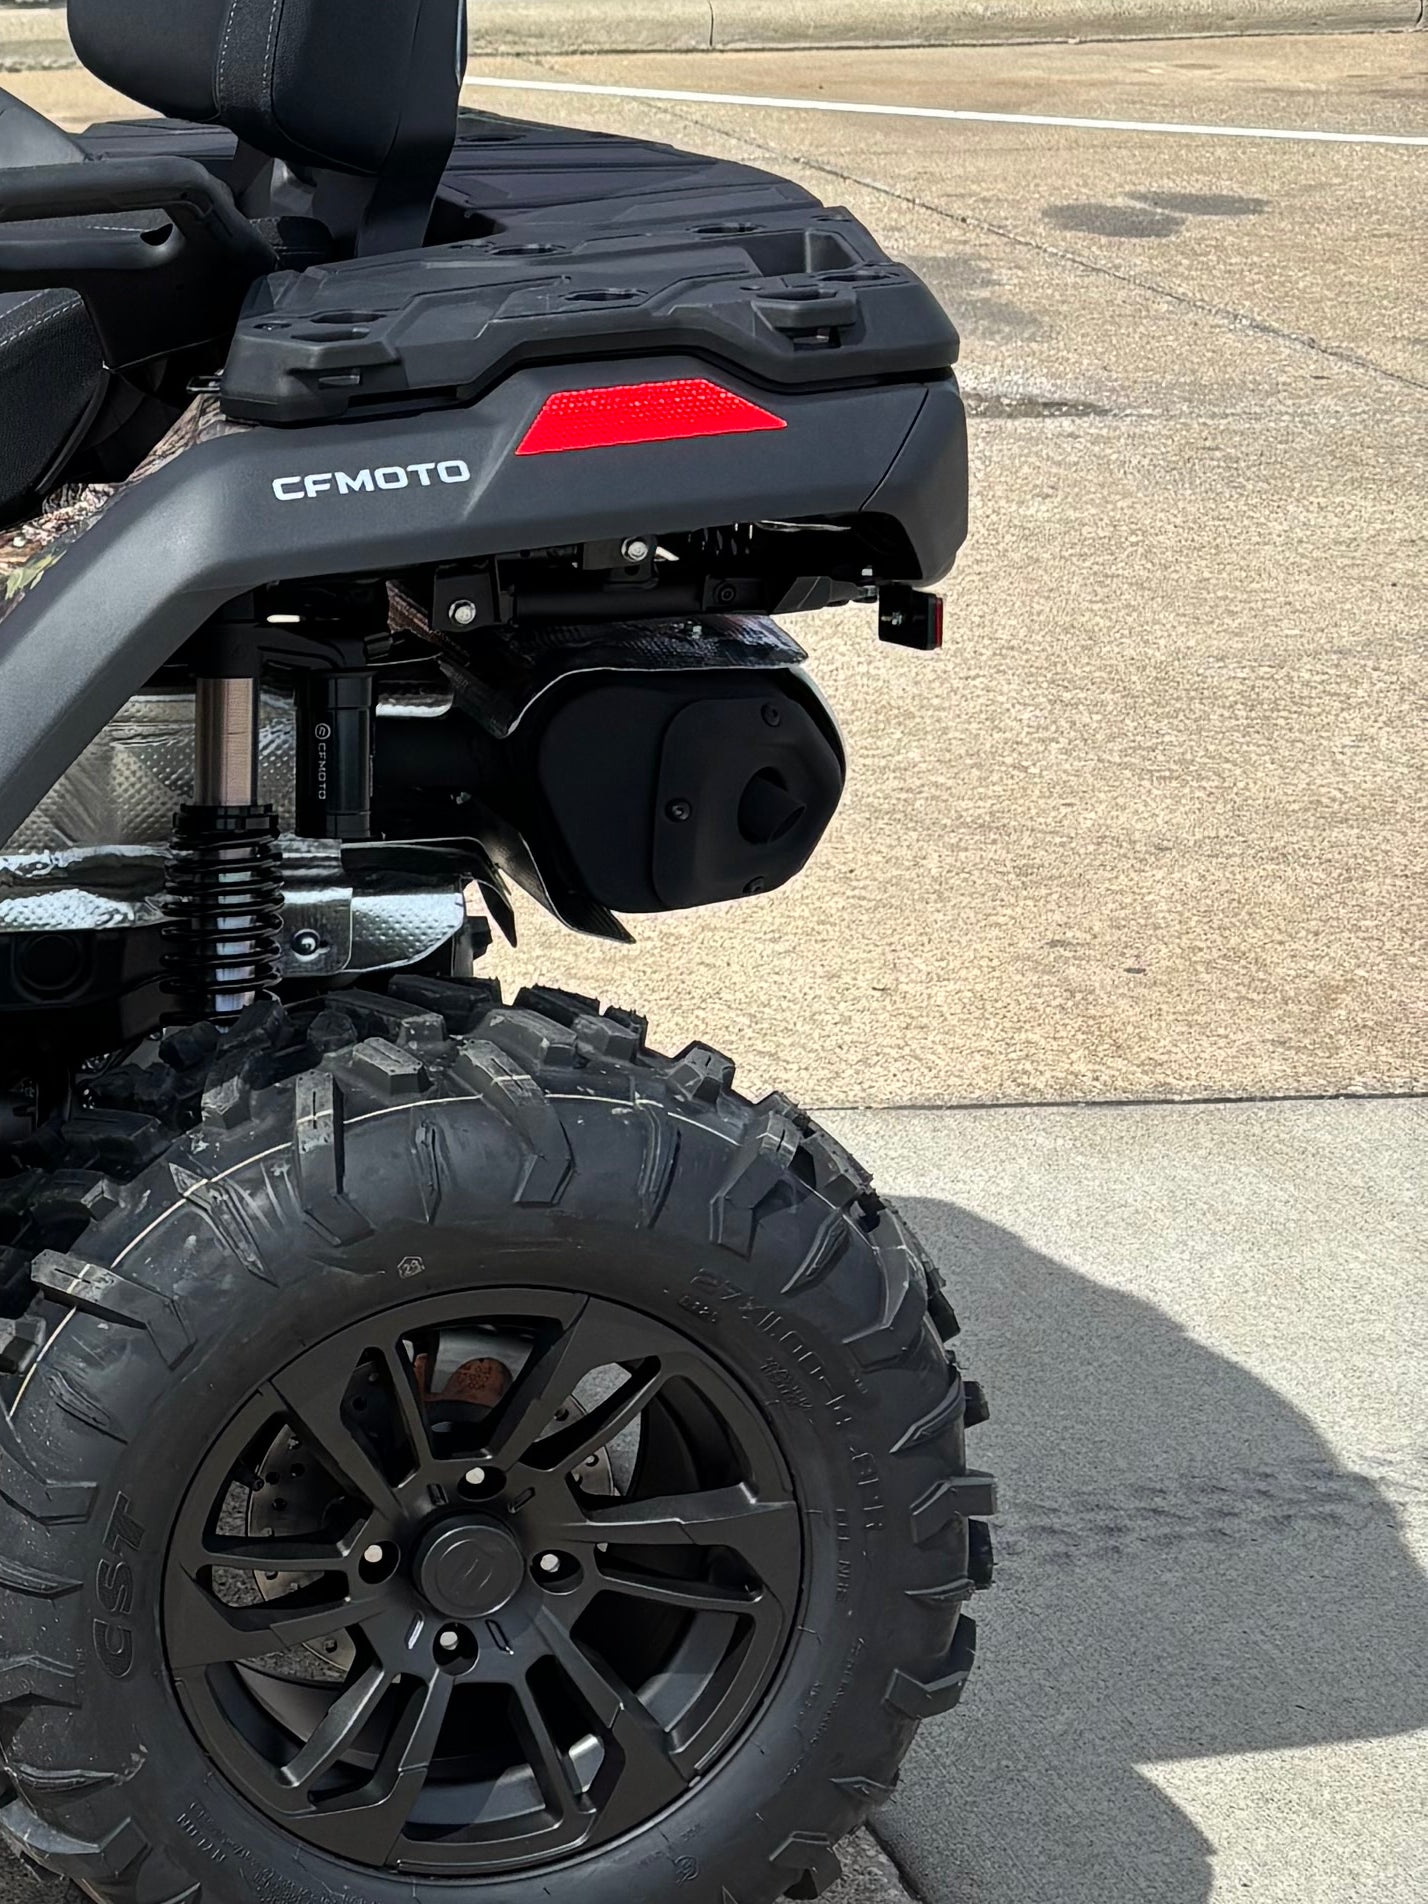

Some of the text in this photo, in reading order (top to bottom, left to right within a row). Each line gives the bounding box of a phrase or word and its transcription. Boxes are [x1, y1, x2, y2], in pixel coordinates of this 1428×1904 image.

[271, 458, 472, 502] CFMOTO
[316, 742, 329, 801] CFMOTO
[92, 1491, 145, 1680] CST
